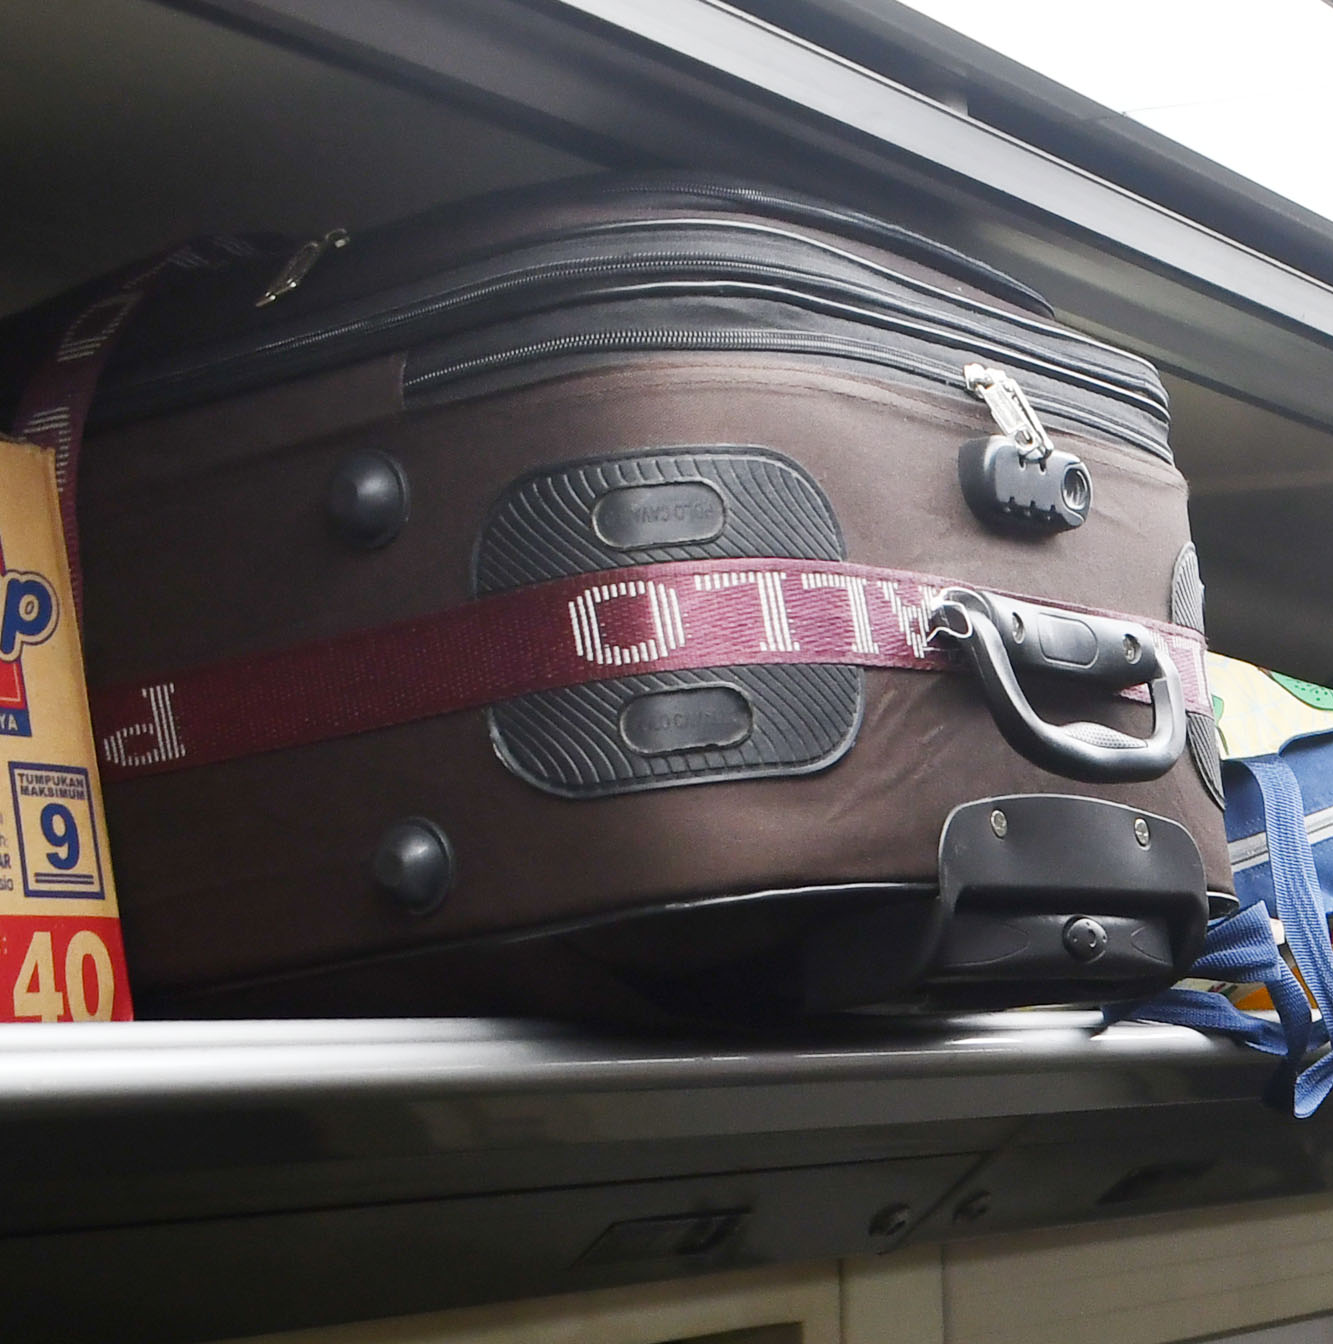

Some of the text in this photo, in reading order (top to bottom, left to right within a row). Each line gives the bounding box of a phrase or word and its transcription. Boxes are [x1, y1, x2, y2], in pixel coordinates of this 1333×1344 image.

[18, 772, 84, 789] TUMPUKAN
[20, 784, 87, 801] MAKSIMUM
[40, 802, 80, 870] 9
[13, 929, 115, 1023] 40
